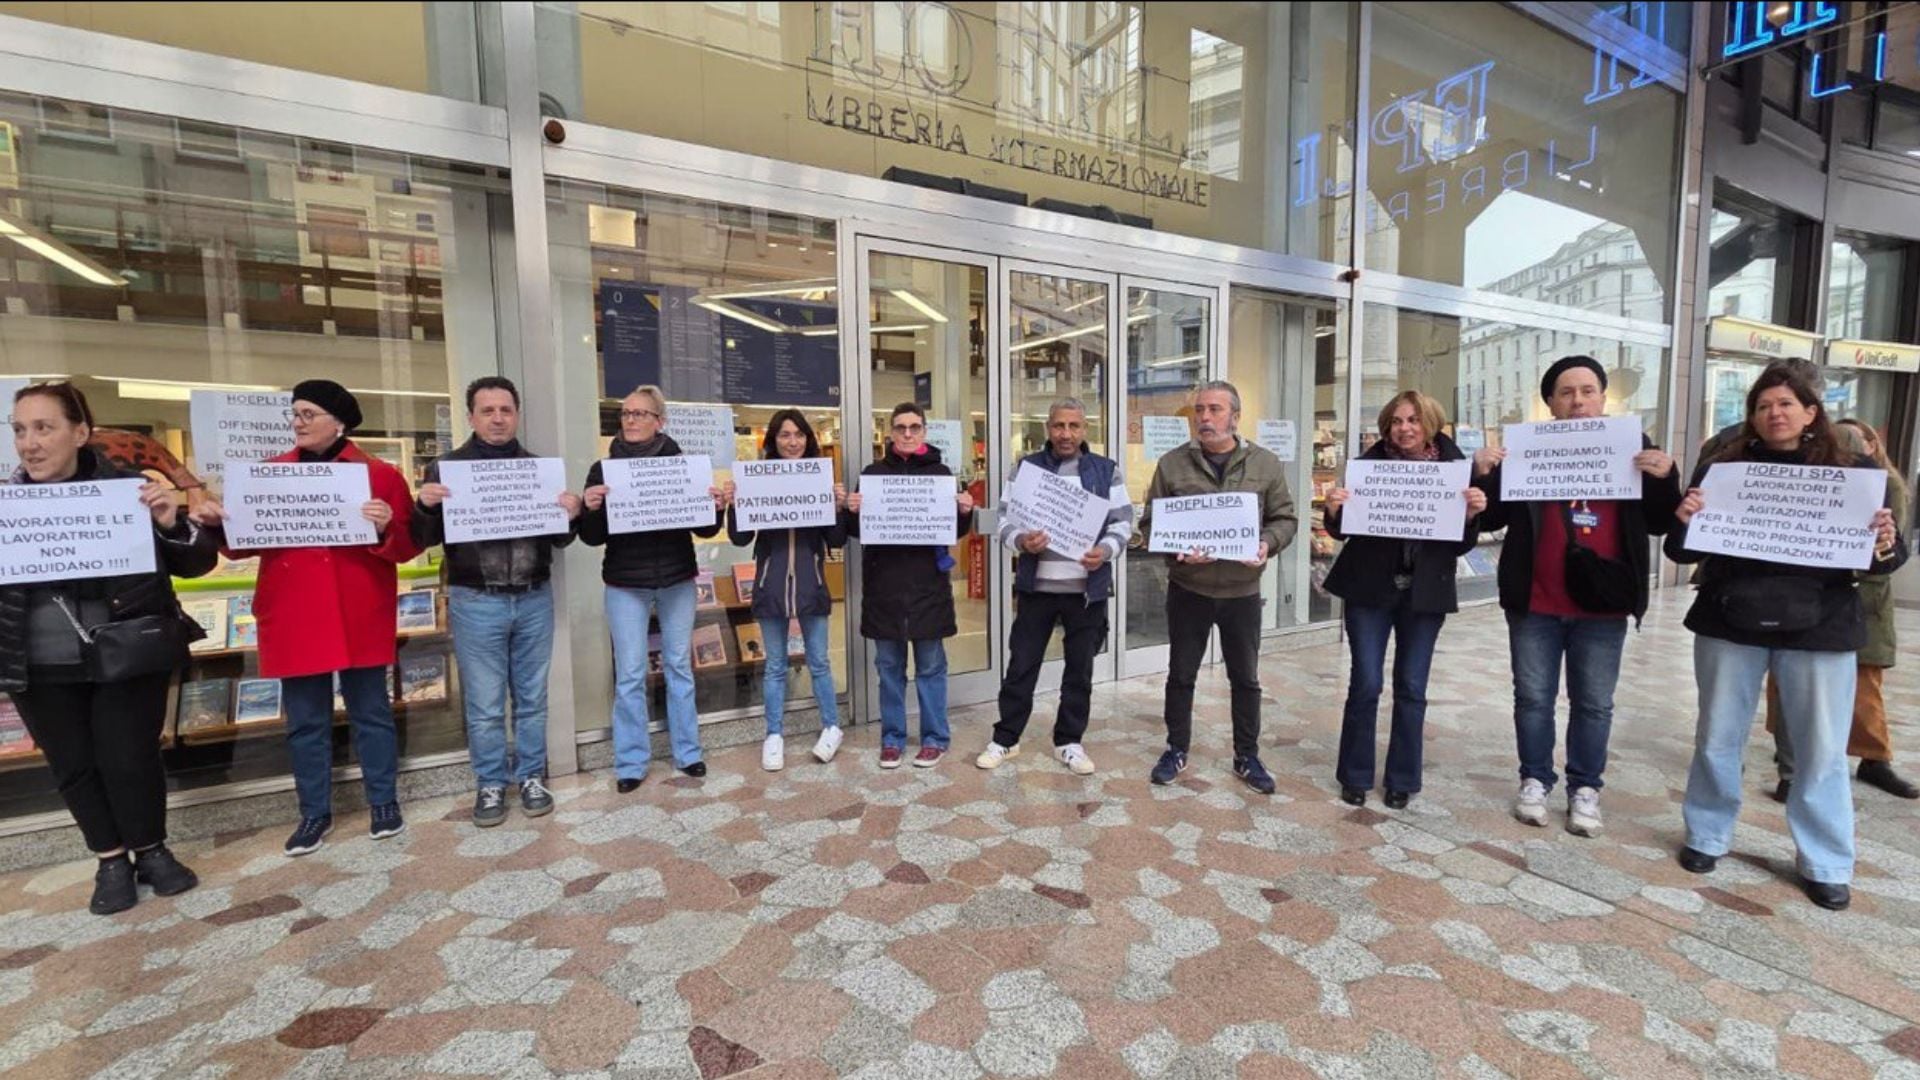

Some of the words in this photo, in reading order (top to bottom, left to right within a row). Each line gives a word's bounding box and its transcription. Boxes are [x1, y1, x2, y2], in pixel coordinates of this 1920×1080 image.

[1864, 351, 1898, 368] UniCredit
[227, 395, 277, 406] HOEPLI
[1535, 423, 1578, 433] HOEPLI
[1583, 421, 1605, 430] SPA
[1525, 447, 1601, 458] DIFENDIAMO
[1605, 446, 1615, 455] IL
[250, 466, 302, 476] HOEPLI
[307, 466, 333, 476] SPA
[744, 464, 792, 474] HOEPLI
[796, 462, 820, 472] SPA
[1374, 464, 1414, 473] HOEPLI
[1418, 464, 1439, 473] SPA
[1532, 460, 1608, 471] PATRIMONIO
[1746, 465, 1803, 478] HOEPLI
[1809, 468, 1845, 480] SPA
[1365, 476, 1433, 486] DIFENDIAMO
[1527, 474, 1600, 484] CULTURALE
[1605, 474, 1612, 482] E
[1, 488, 64, 498] HOEPLI
[69, 485, 101, 496] SPA
[1509, 488, 1614, 497] PROFESSIONALE
[1743, 480, 1827, 493] LAVORATORI
[1833, 486, 1842, 494] E
[244, 494, 329, 504] DIFENDIAMO
[334, 495, 344, 503] IL
[1355, 488, 1400, 497] NOSTRO
[1403, 490, 1441, 499] POSTO
[1444, 492, 1455, 500] DI
[1737, 492, 1824, 506] LAVORATRICI
[1829, 499, 1844, 508] IN
[737, 495, 816, 507] PATRIMONIO
[820, 494, 832, 503] DI
[1165, 499, 1212, 511] HOEPLI
[1217, 496, 1243, 506] SPA
[256, 508, 339, 518] PATRIMONIO
[1369, 502, 1414, 510] LAVORO
[1428, 504, 1436, 512] IL
[1746, 505, 1826, 519] AGITAZIONE
[96, 514, 105, 525] E
[113, 514, 134, 524] LE
[749, 512, 798, 523] MILANO
[1369, 513, 1435, 524] PATRIMONIO
[1697, 512, 1723, 522] PER
[1726, 515, 1736, 524] IL
[1741, 517, 1792, 529] DIRITTO
[1795, 523, 1812, 532] AL
[254, 521, 334, 532] CULTURALE
[339, 521, 346, 529] E
[1368, 525, 1432, 536] CULTURALE
[2, 529, 111, 545] LAVORATRICI
[1154, 528, 1236, 540] PATRIMONIO
[1242, 527, 1254, 538] DI
[1712, 527, 1766, 539] CONTRO
[1770, 533, 1867, 549] PROSPETTIVE
[237, 534, 350, 546] PROFESSIONALE
[40, 546, 76, 557] NON
[1723, 539, 1735, 548] DI
[1739, 542, 1835, 560] LIQUIDAZIONE
[11, 559, 103, 576] LIQUIDANO
